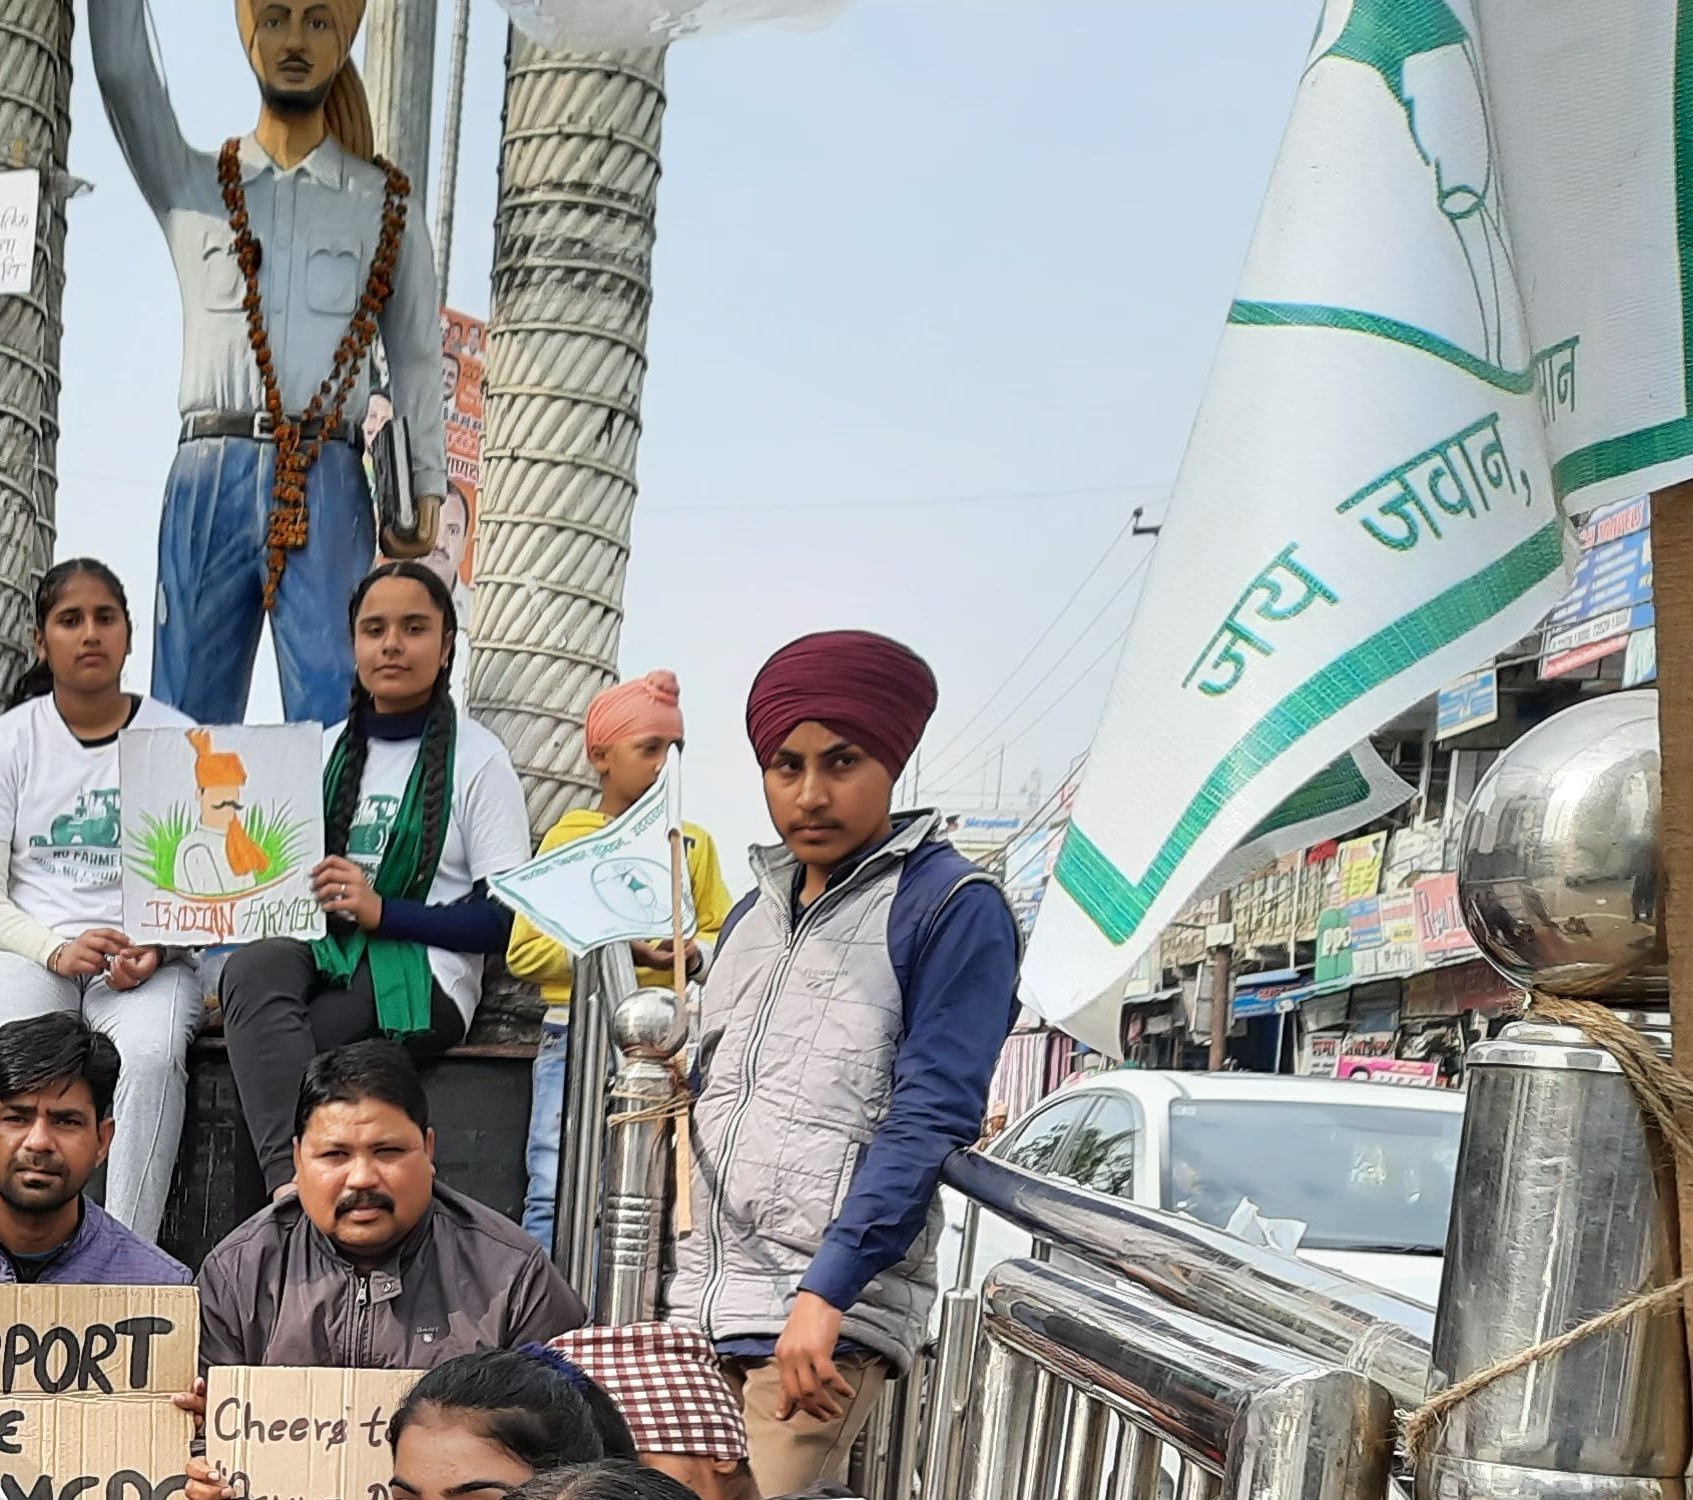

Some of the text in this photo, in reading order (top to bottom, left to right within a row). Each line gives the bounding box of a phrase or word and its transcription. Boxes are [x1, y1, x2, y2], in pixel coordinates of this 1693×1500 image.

[1181, 540, 1340, 699] जय
[241, 894, 321, 939] FARMER
[213, 1396, 349, 1452] Cheers
